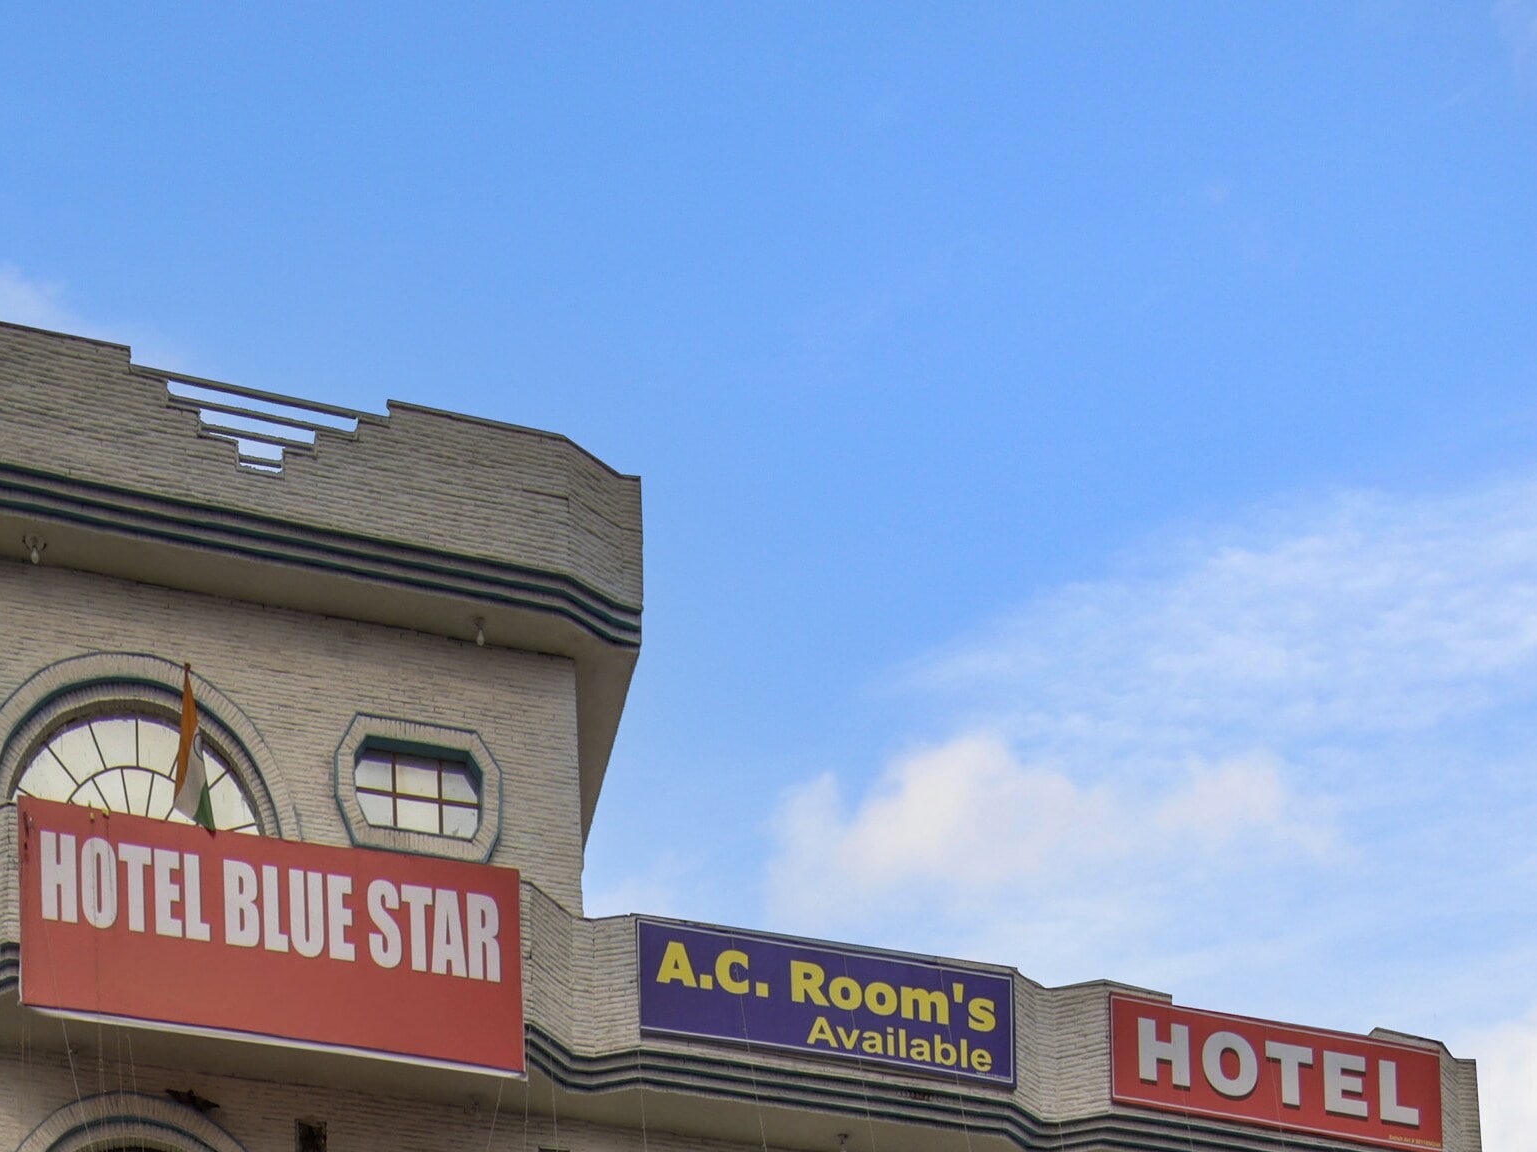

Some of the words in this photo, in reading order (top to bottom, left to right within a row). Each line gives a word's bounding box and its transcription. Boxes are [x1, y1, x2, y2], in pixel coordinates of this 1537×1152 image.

[40, 831, 211, 942] HOTEL
[223, 858, 356, 962] BLUE
[368, 880, 501, 983] STAR
[656, 941, 769, 998] A.C.
[790, 960, 996, 1032] Room's
[807, 1016, 992, 1072] Available
[1138, 1017, 1419, 1126] HOTEL
